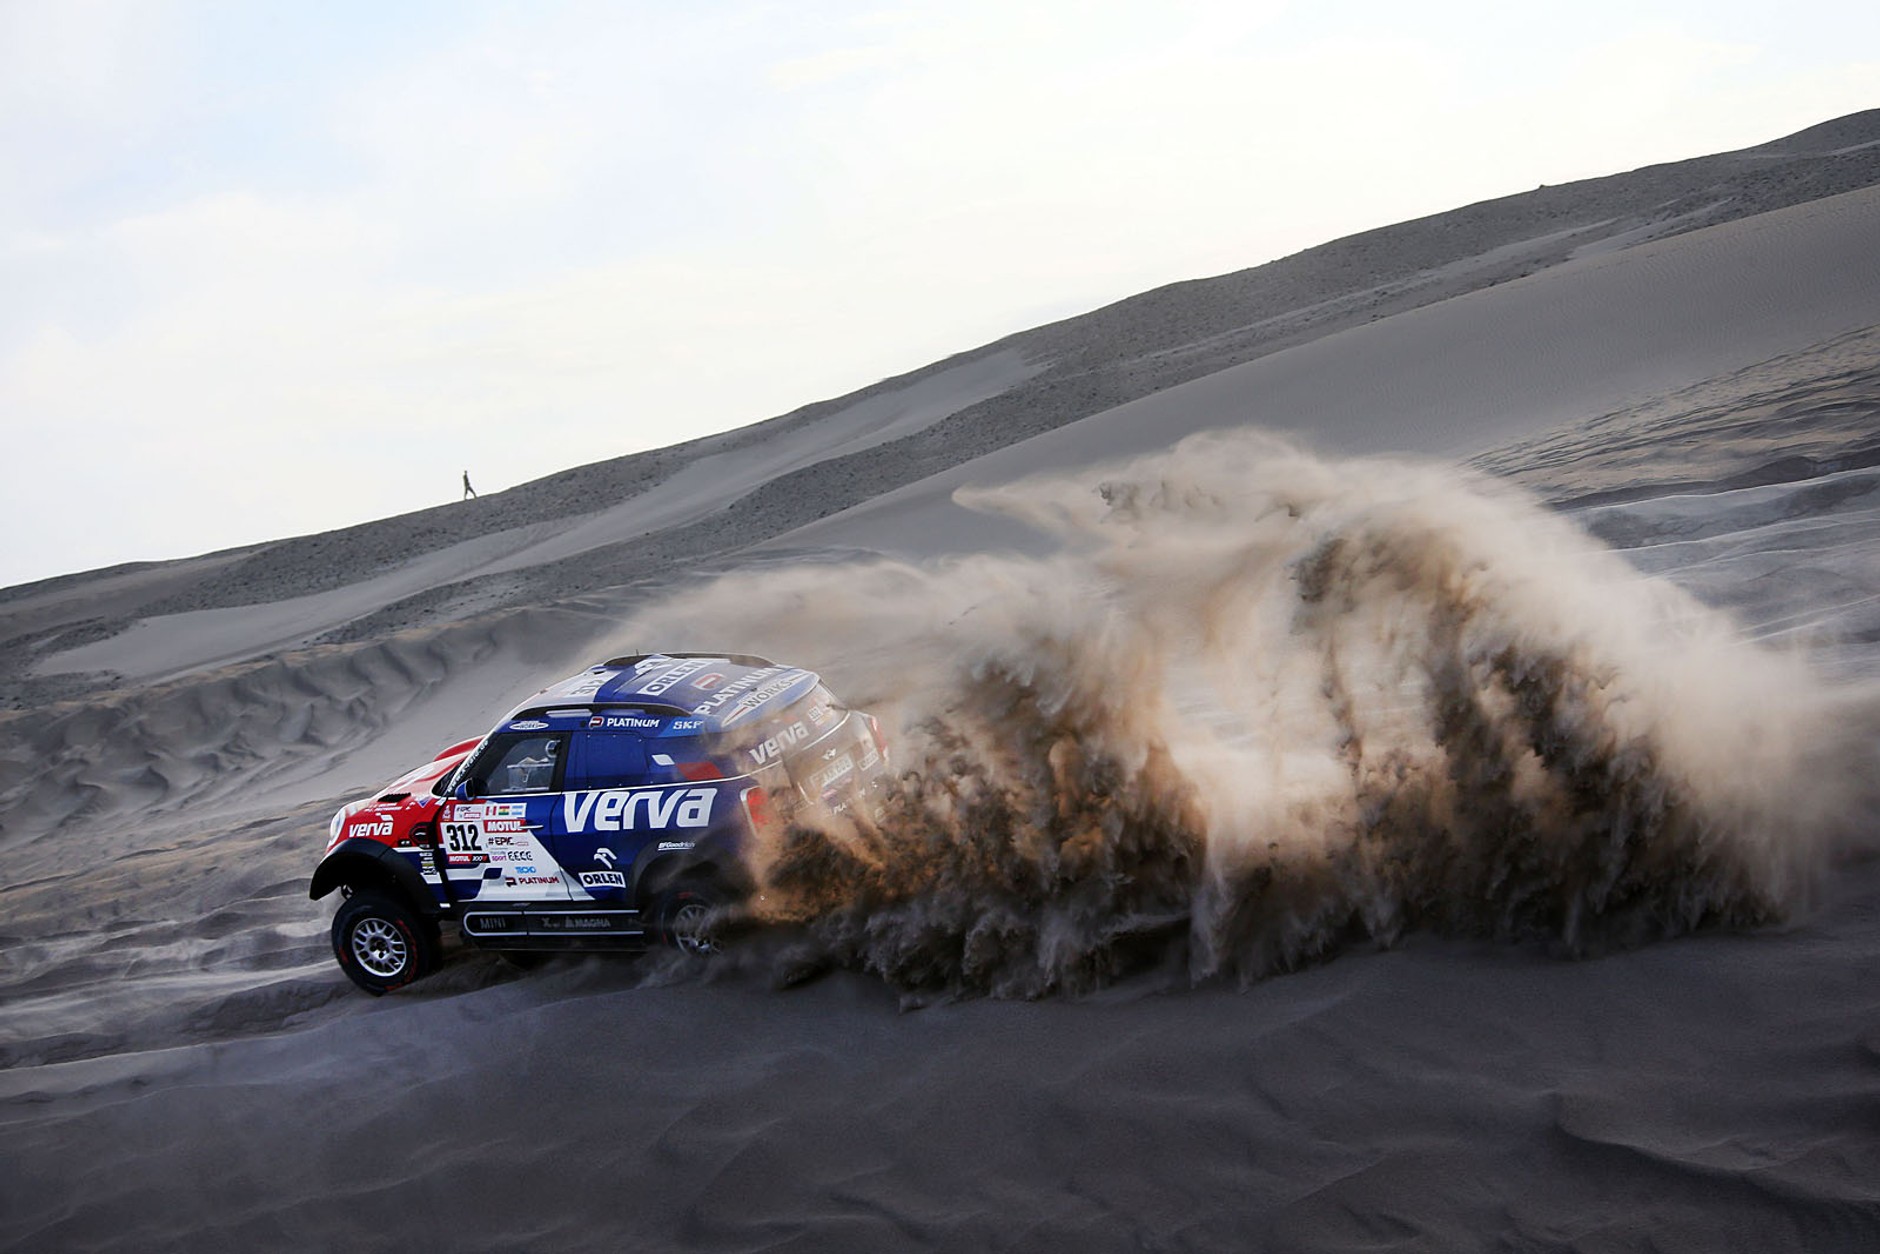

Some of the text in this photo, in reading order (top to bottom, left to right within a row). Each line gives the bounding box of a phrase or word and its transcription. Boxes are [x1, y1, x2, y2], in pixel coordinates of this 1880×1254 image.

[647, 660, 703, 693] ORLEN
[693, 666, 782, 715] PLATINUM
[744, 678, 793, 708] WORKS
[607, 718, 660, 728] PLATINUM
[673, 721, 704, 730] SKF
[749, 720, 809, 765] verva
[564, 788, 718, 833] verva
[349, 822, 393, 838] verva
[487, 821, 523, 832] MOTUL
[446, 825, 482, 851] 312
[583, 874, 622, 885] ORLEN
[480, 918, 506, 929] MINI
